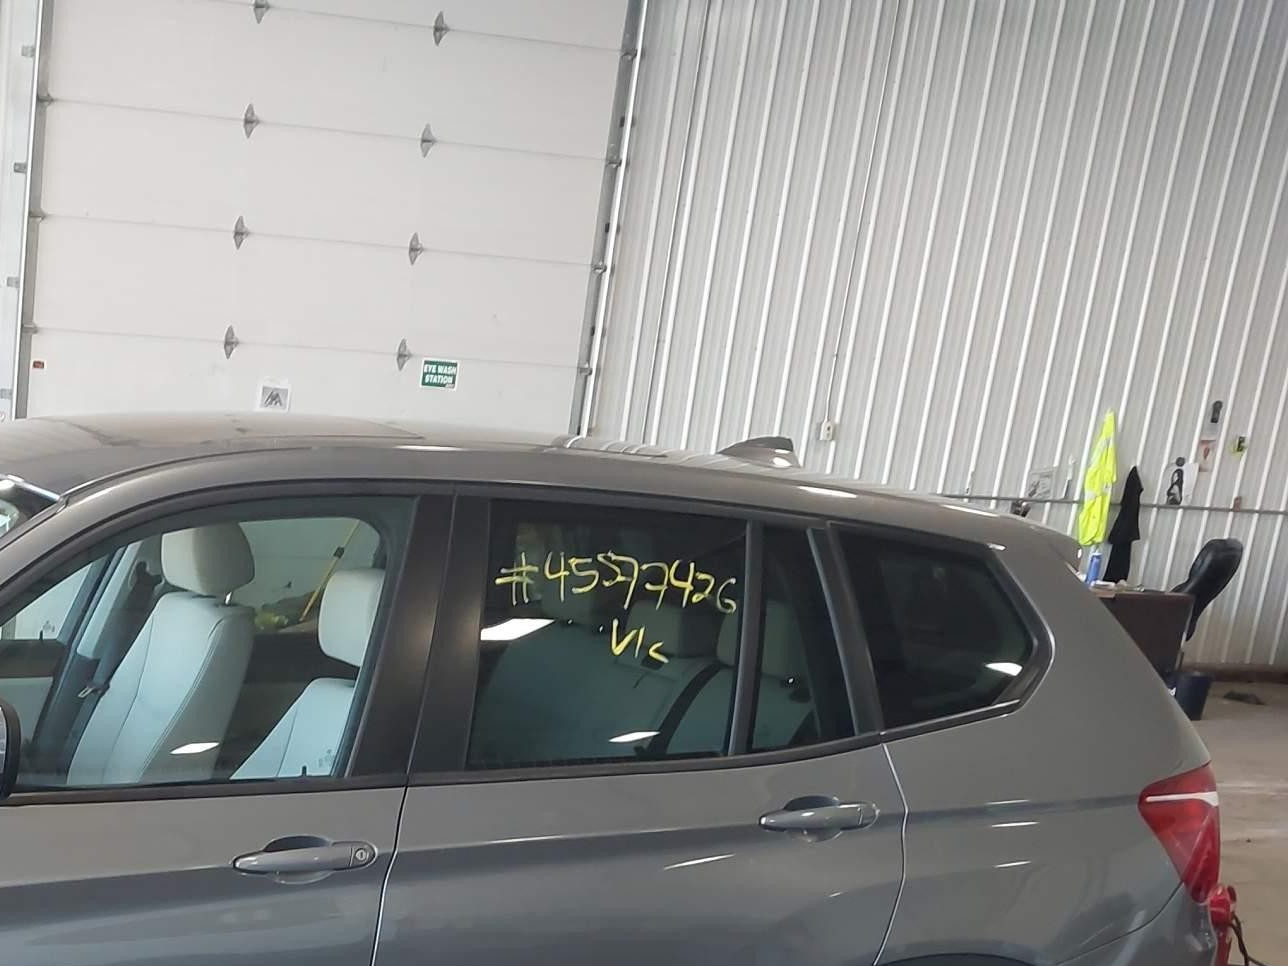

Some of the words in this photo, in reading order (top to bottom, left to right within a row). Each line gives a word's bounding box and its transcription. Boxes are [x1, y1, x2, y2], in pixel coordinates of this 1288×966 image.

[423, 364, 437, 373] EYE
[437, 365, 457, 375] WASH
[424, 374, 453, 384] STATION
